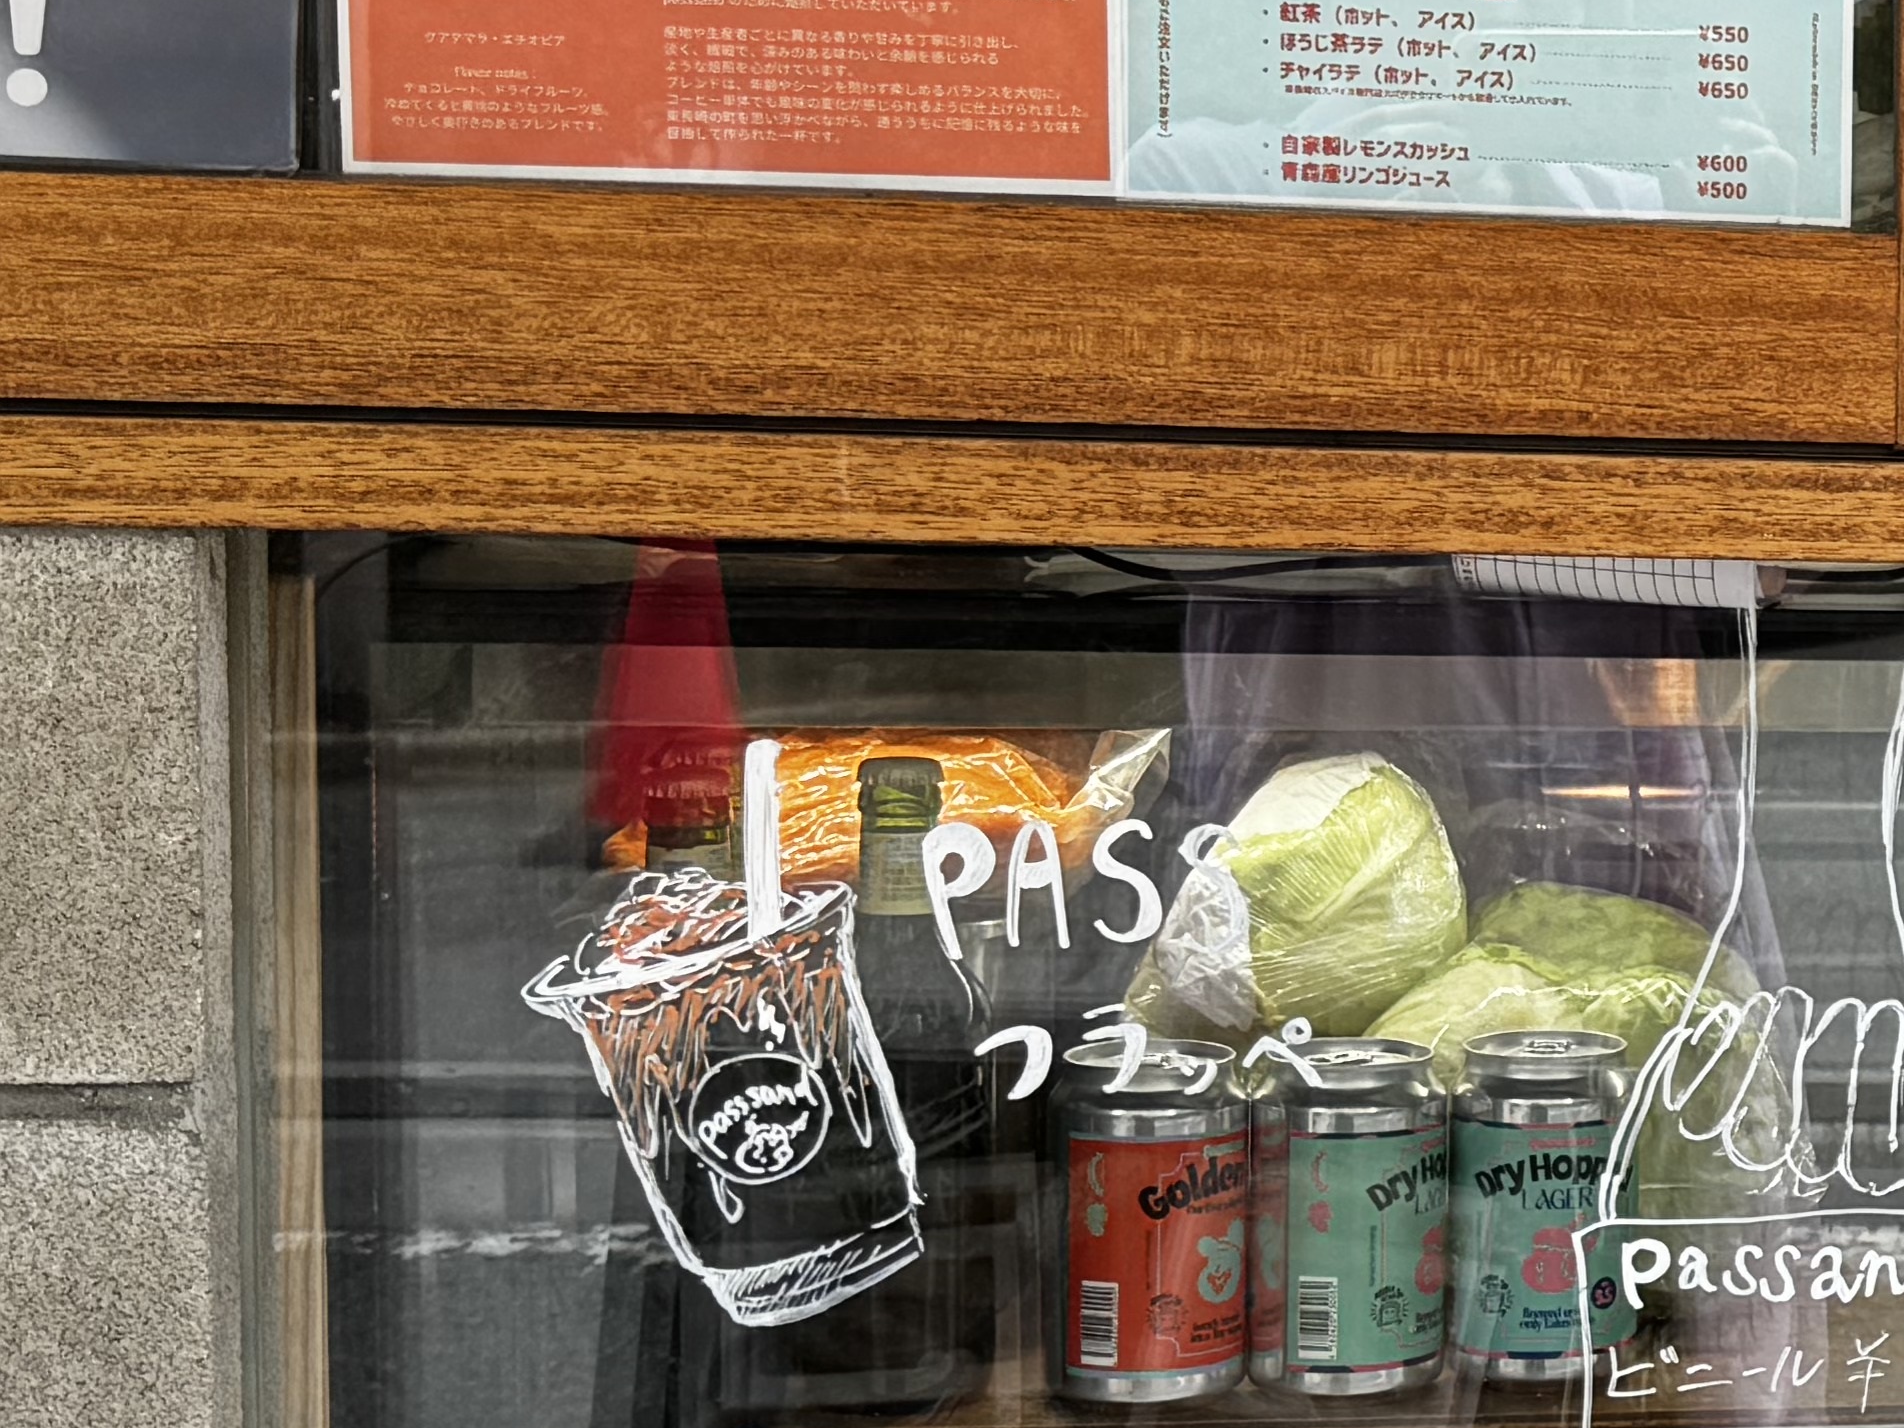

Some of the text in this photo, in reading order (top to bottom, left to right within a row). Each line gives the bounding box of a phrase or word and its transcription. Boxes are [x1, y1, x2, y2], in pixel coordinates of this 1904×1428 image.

[1280, 2, 1320, 23] 紅茶
[1699, 24, 1749, 43] ¥550
[1280, 33, 1382, 55] ほうじ茶ラテ
[1699, 52, 1749, 71] ¥650
[1280, 62, 1360, 80] チャイラテ
[1699, 81, 1749, 99] ¥650
[1281, 135, 1747, 172] 自家製レモンスカッシュ ¥600
[1281, 162, 1747, 200] 青森産リンゴジュース ¥500
[922, 819, 1252, 960] PASS
[974, 1004, 1323, 1100] フラッペ
[1366, 1165, 1417, 1212] Dry
[1475, 1160, 1525, 1199] Dry
[1522, 1187, 1594, 1211] LAGER
[1606, 1342, 1824, 1399] ビニール
